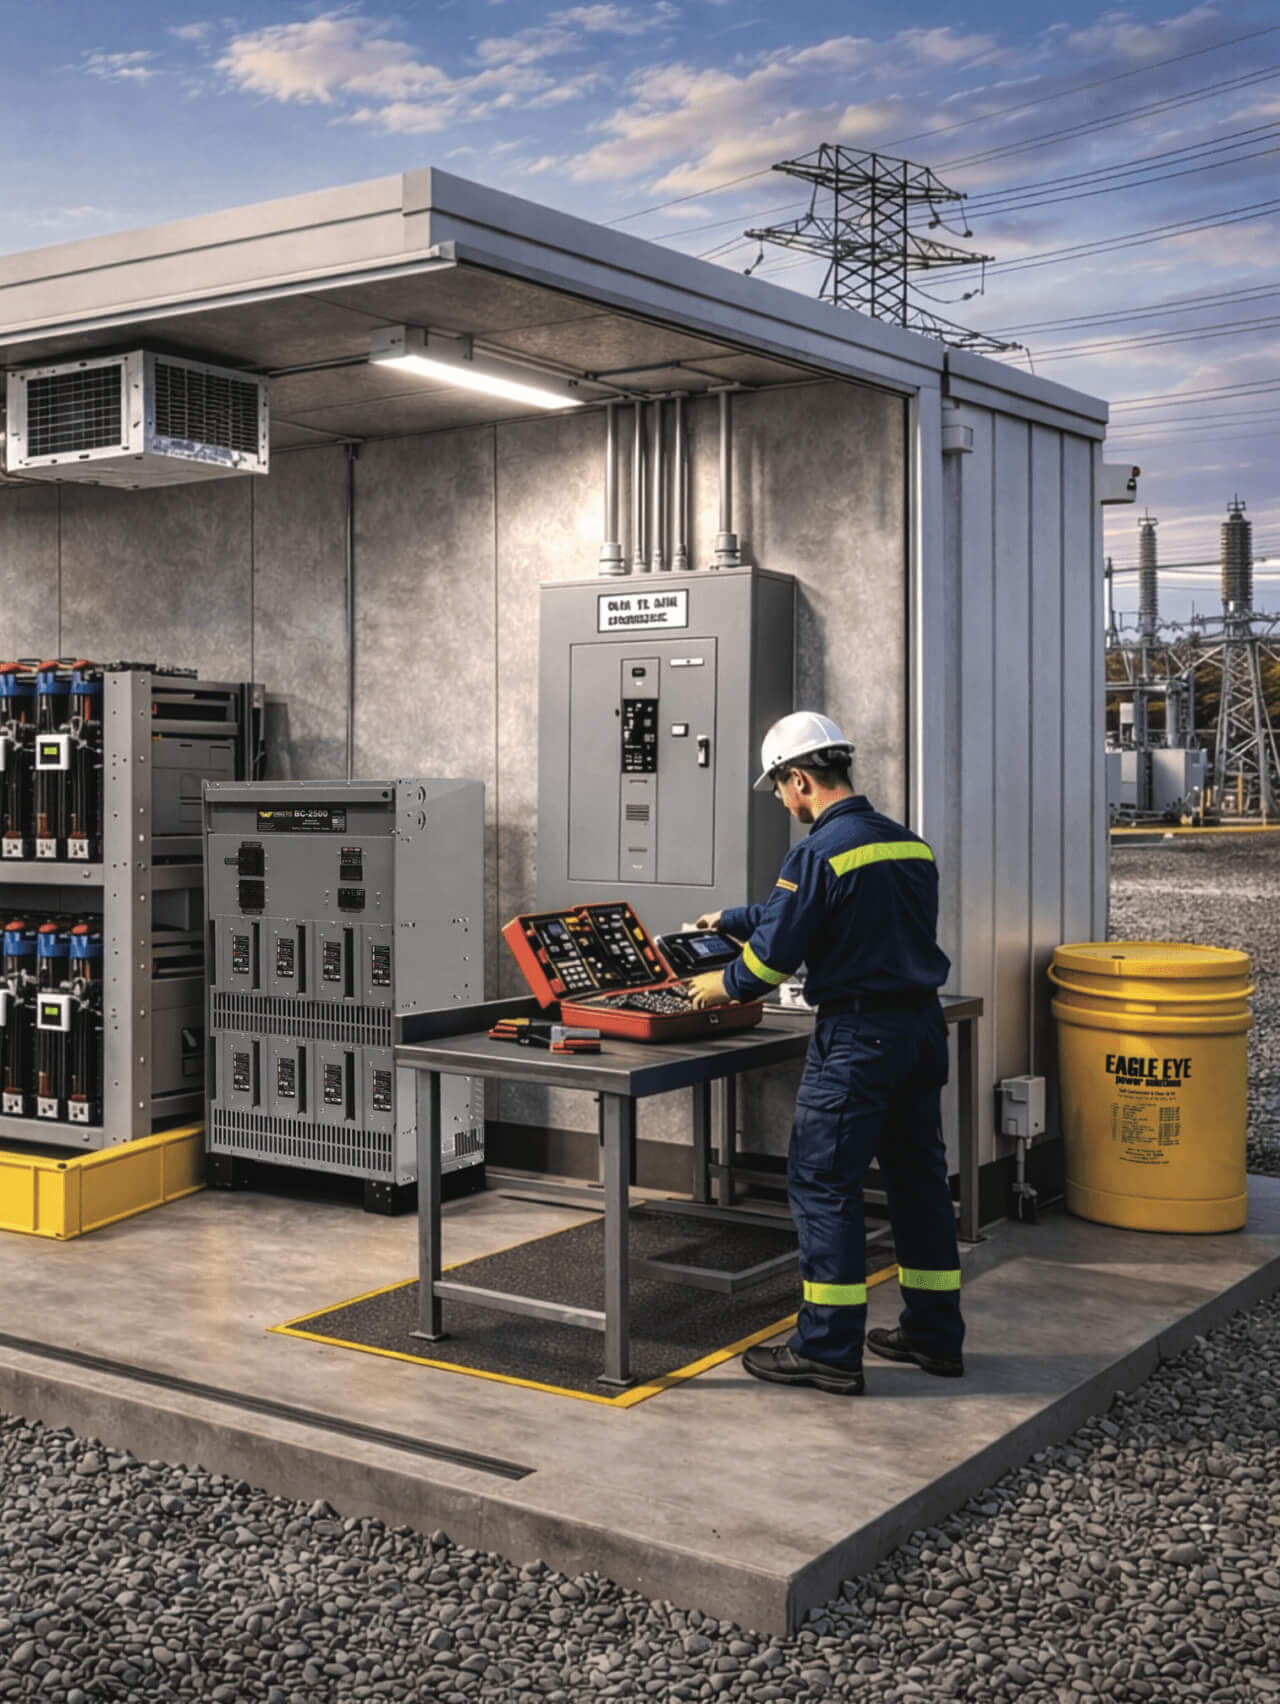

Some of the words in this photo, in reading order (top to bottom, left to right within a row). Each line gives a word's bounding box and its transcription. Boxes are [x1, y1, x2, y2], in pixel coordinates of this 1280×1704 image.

[1105, 1054, 1158, 1079] EAGLE
[1163, 1058, 1192, 1079] EYE
[1115, 1076, 1143, 1086] power
